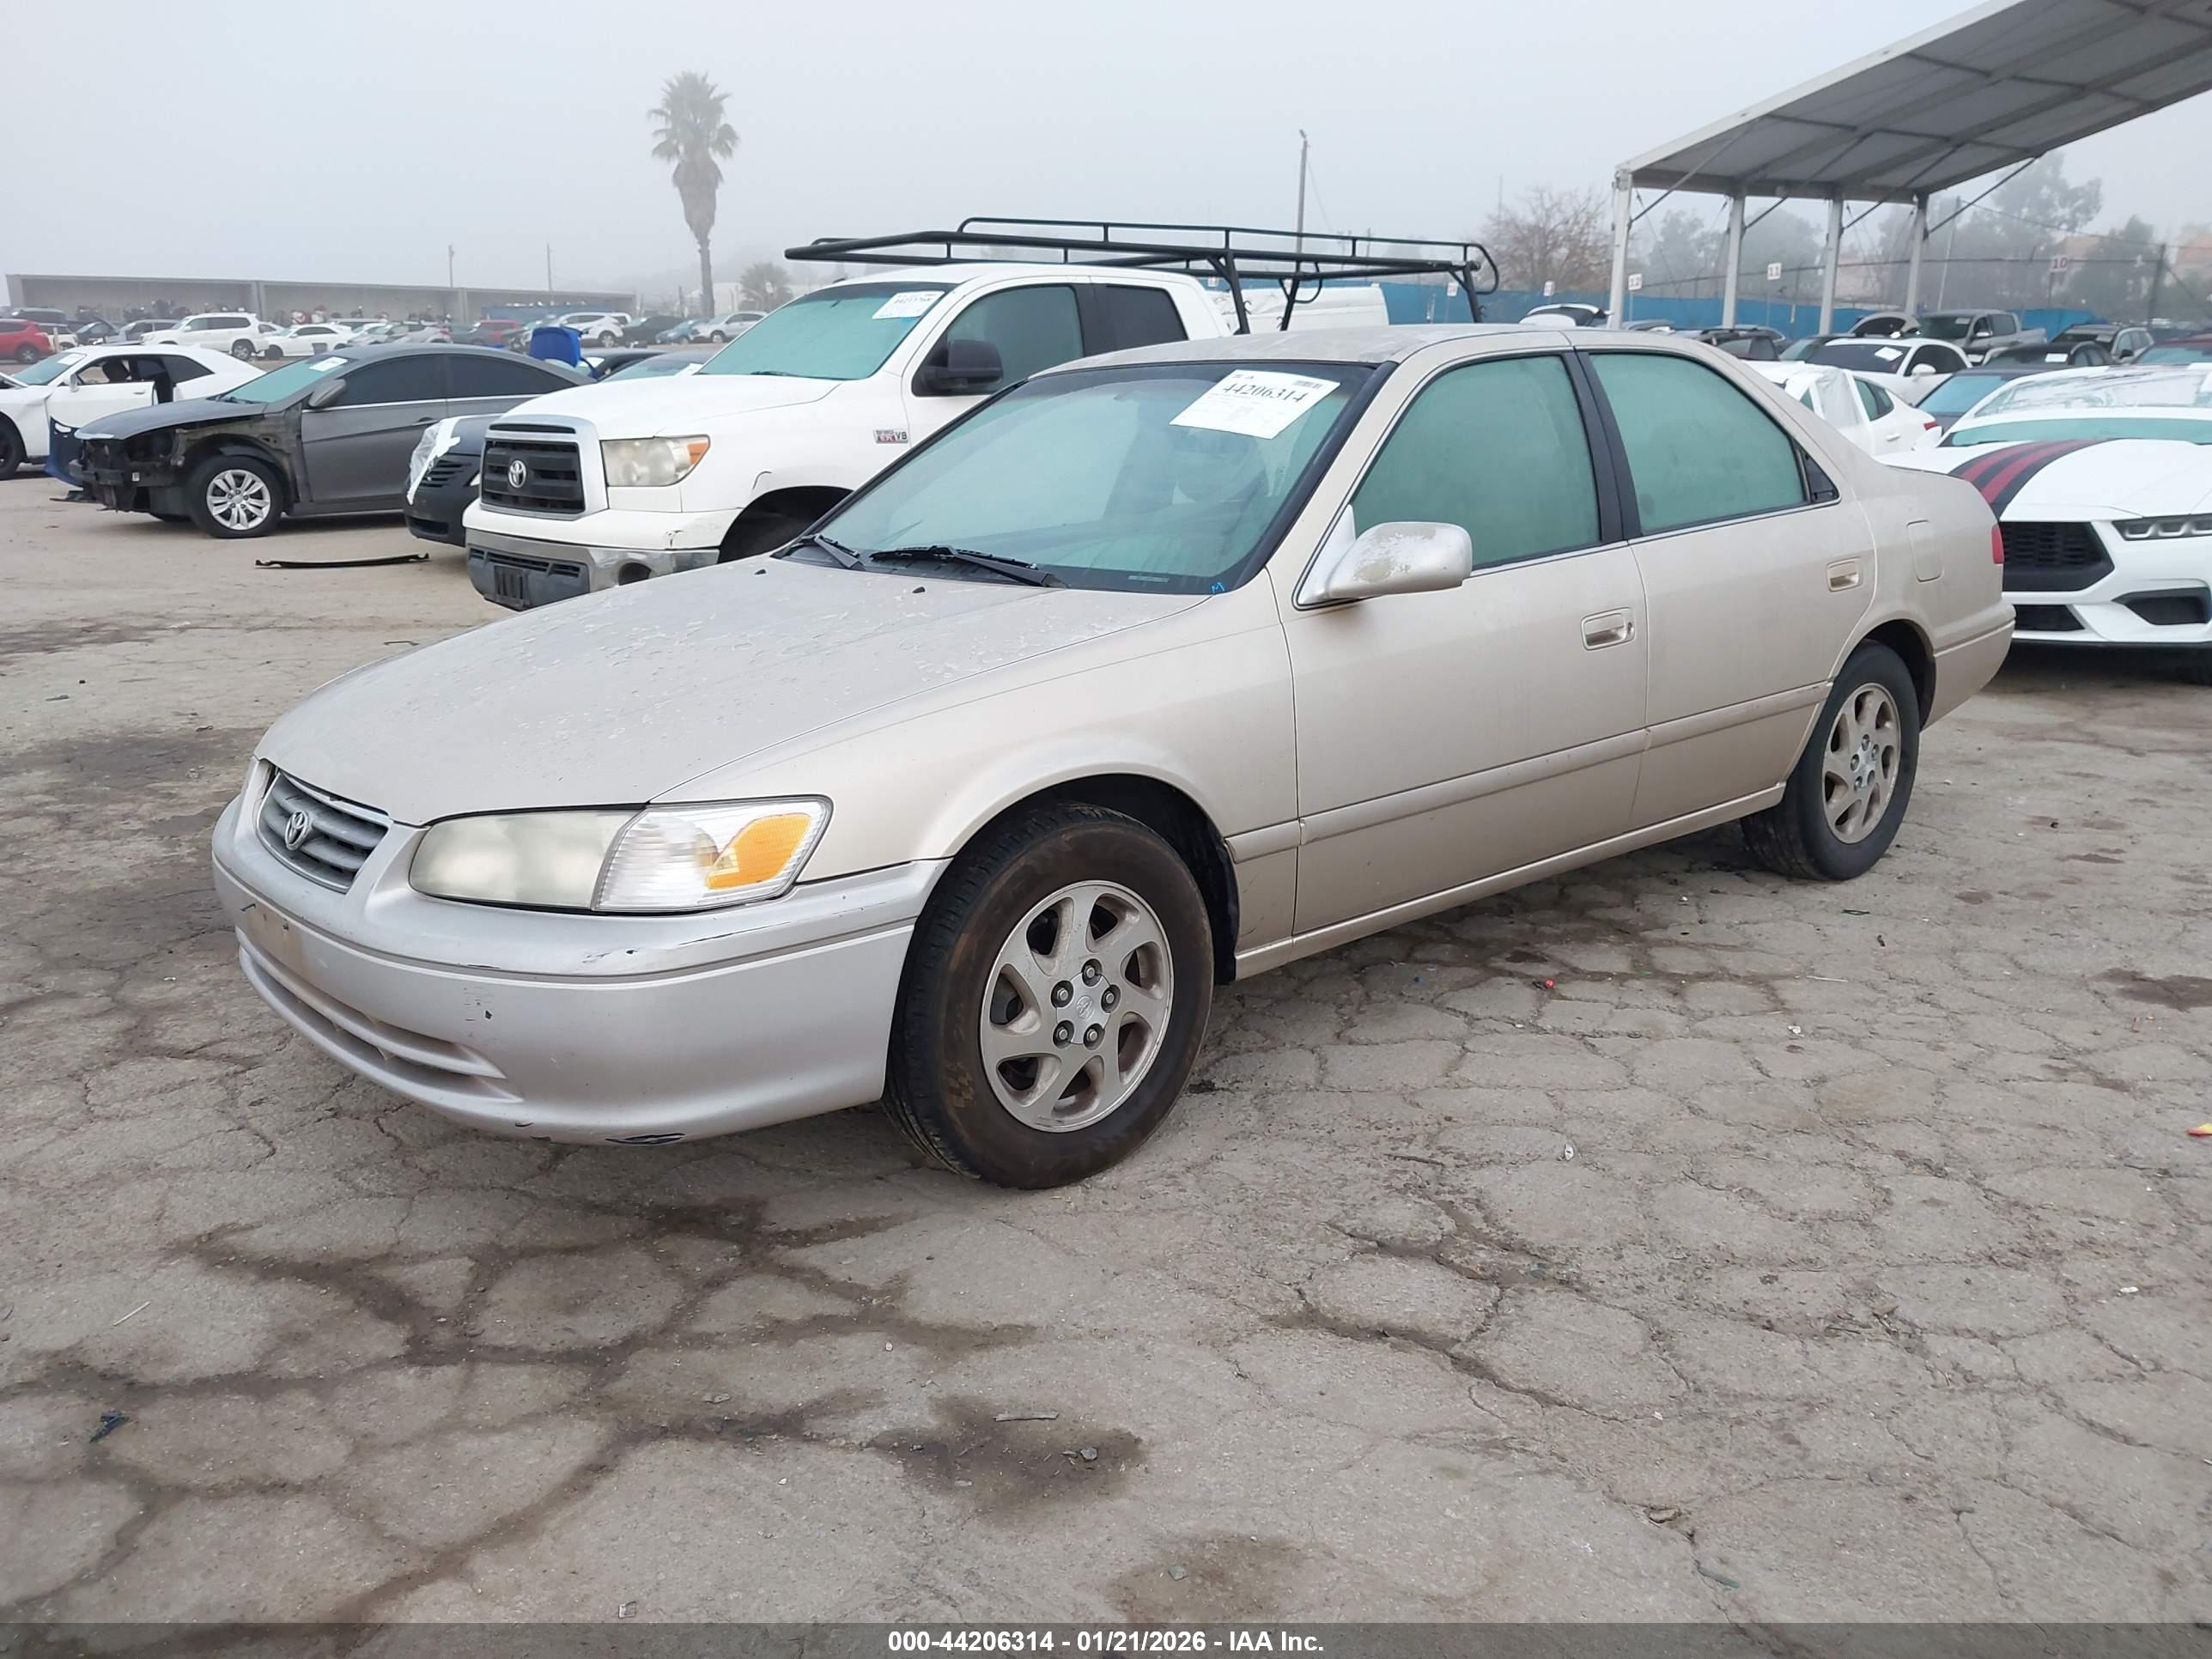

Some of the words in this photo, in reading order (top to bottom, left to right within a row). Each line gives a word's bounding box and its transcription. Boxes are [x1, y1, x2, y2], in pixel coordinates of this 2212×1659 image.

[2053, 257, 2069, 269] 10
[1223, 382, 1310, 404] 44206314
[895, 430, 908, 441] V8
